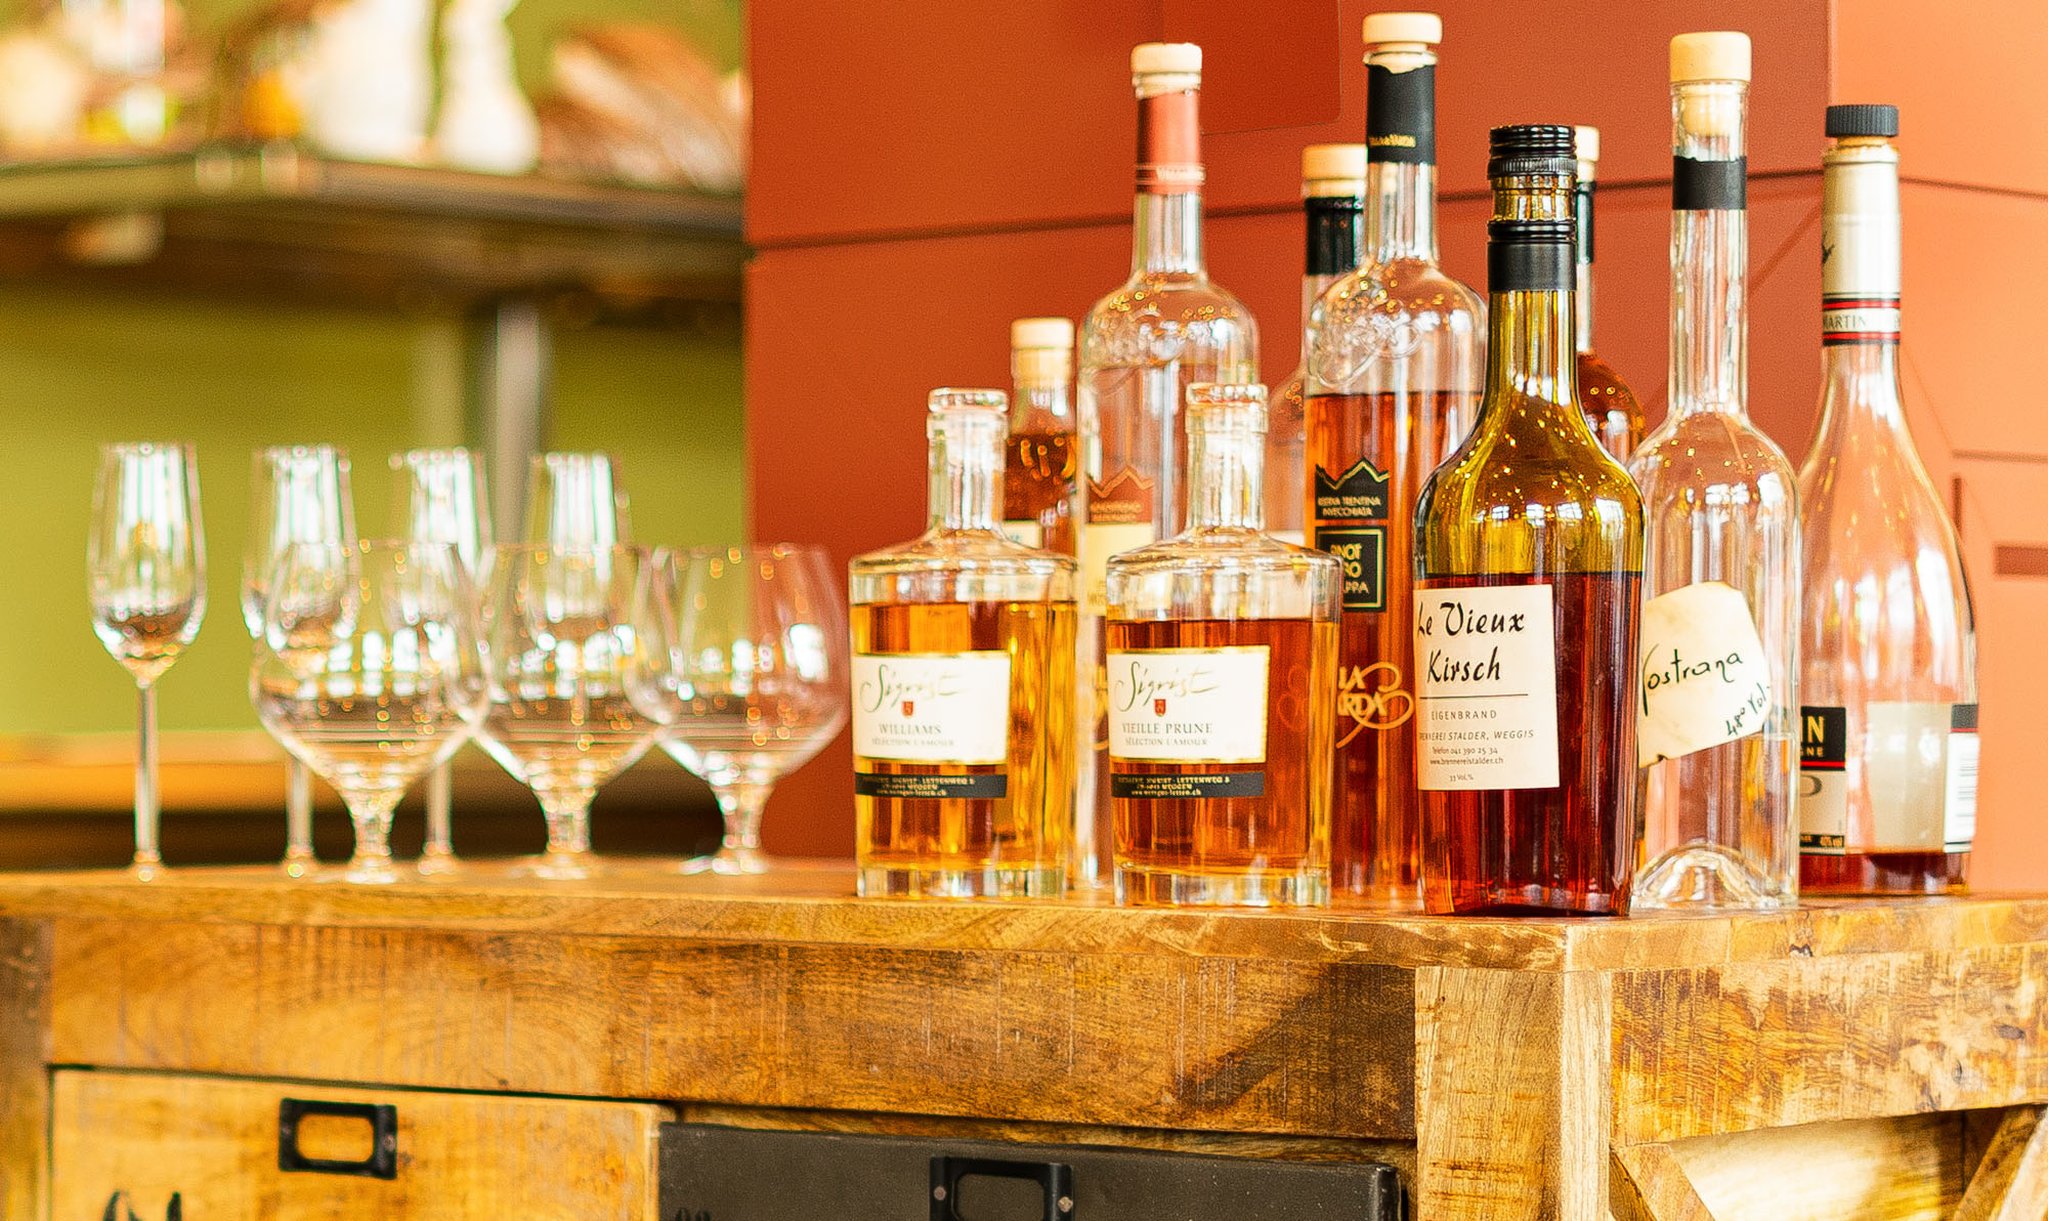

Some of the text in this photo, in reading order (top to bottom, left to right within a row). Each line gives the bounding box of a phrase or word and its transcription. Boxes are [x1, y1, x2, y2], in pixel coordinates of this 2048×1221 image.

[1417, 602, 1525, 638] Le Vieux
[1427, 646, 1500, 683] Kirsch
[1114, 661, 1221, 712] Sigrist
[1431, 709, 1497, 721] EIGENBRAND
[879, 723, 942, 735] WILLIAMS
[1122, 722, 1213, 734] VIEILLE PRUNE
[1449, 730, 1489, 742] STALDER,
[1494, 729, 1534, 740] WEGGIS
